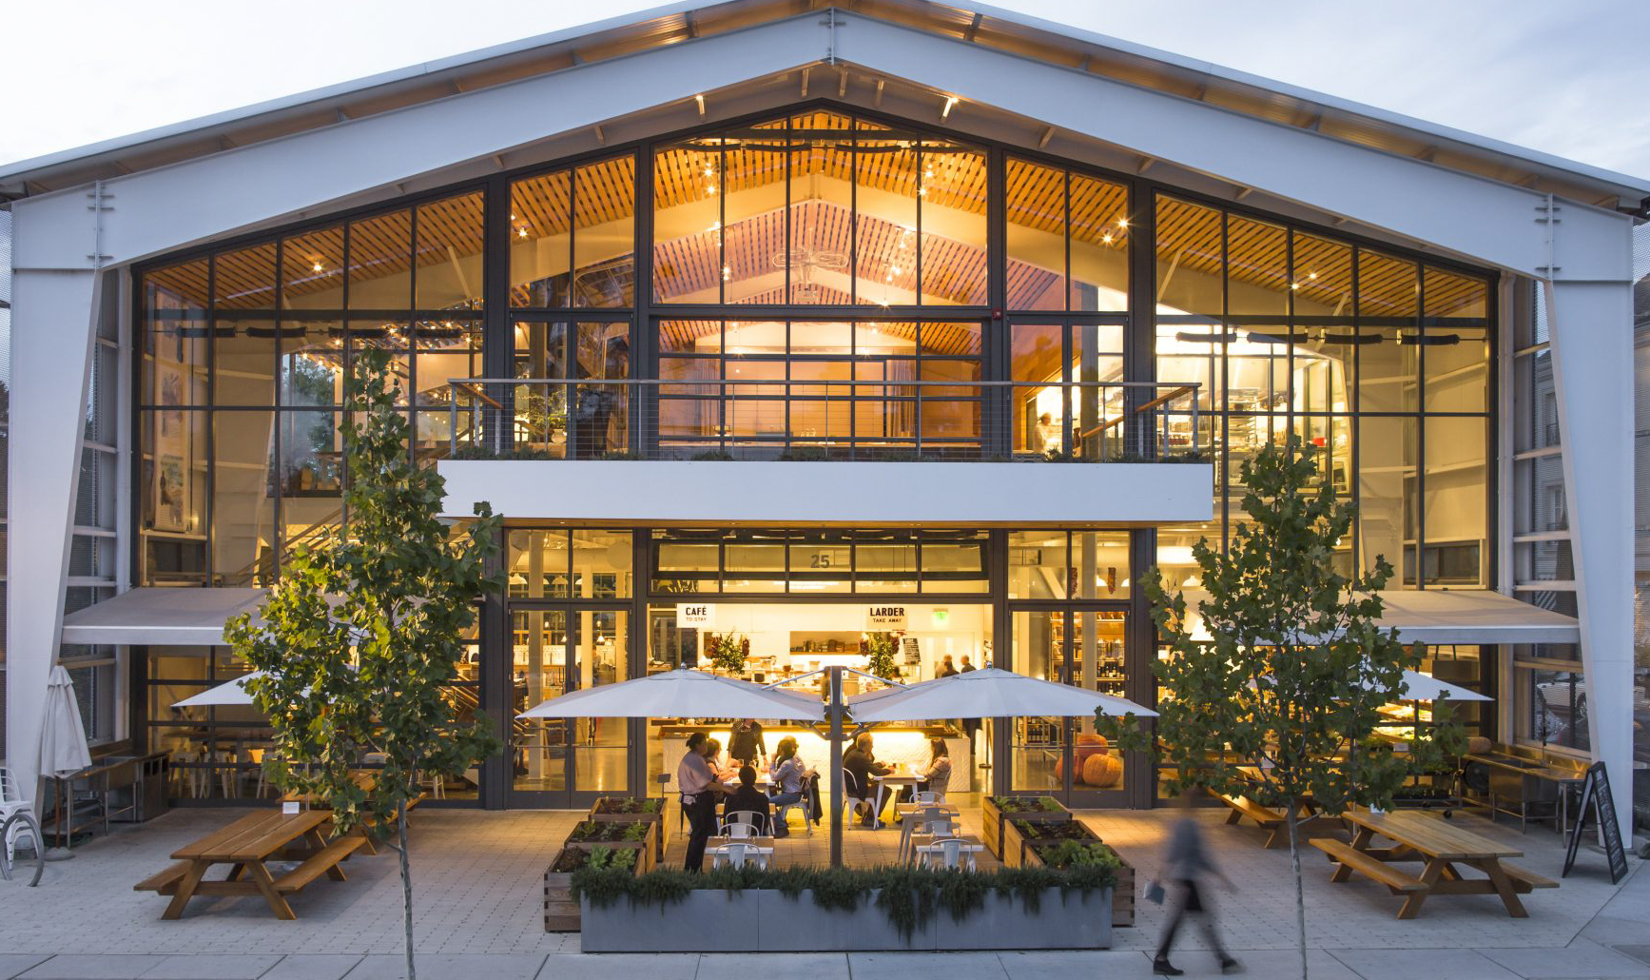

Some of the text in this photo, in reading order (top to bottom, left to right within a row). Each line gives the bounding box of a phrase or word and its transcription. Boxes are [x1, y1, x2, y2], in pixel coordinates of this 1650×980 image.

[810, 554, 830, 569] 25
[685, 605, 707, 616] CAFÉ
[870, 607, 905, 617] LARDER
